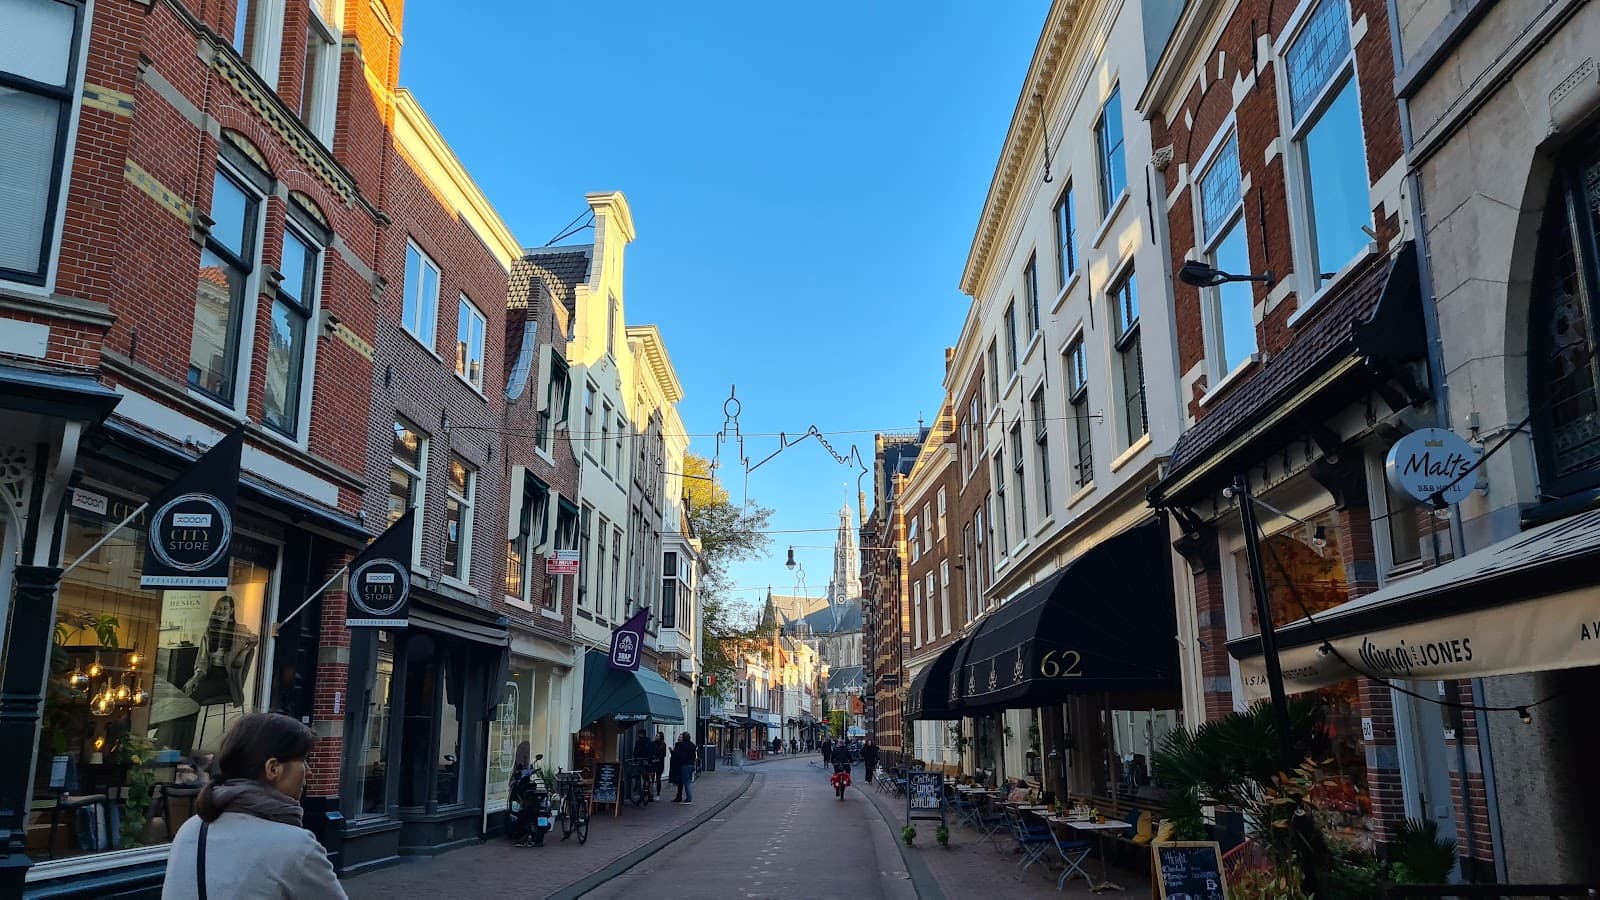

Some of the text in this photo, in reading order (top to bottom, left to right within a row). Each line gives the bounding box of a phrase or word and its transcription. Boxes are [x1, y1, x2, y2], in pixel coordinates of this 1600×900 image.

[1403, 451, 1471, 478] Malts
[170, 529, 210, 541] CITY
[169, 541, 209, 551] STORE
[364, 584, 393, 593] CITY
[364, 593, 394, 601] STORE
[1420, 637, 1473, 666] JONES
[1041, 650, 1082, 677] 62
